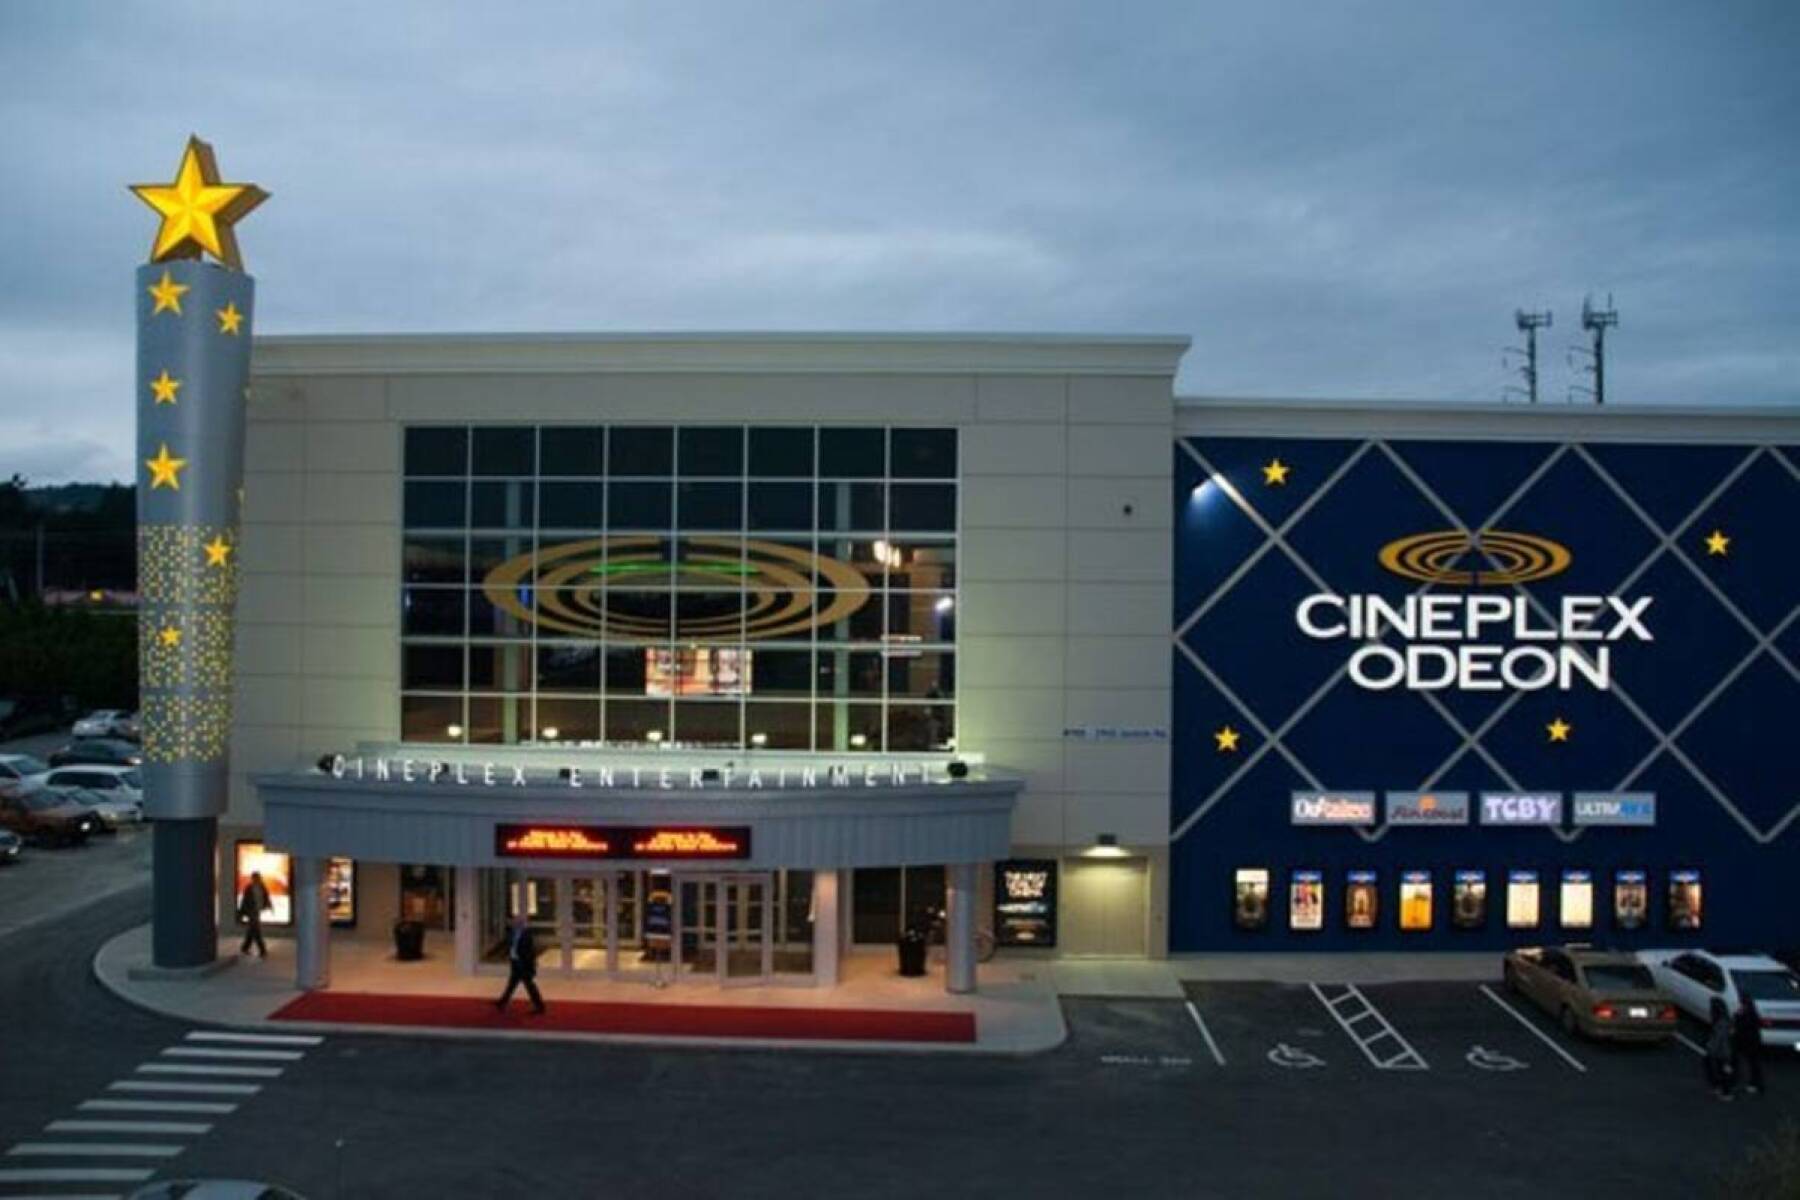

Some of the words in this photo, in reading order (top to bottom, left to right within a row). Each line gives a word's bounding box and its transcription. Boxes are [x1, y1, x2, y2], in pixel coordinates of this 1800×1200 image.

[1296, 594, 1654, 640] CINEPLEX
[1348, 645, 1610, 690] ODEON
[1486, 797, 1557, 820] TCBY
